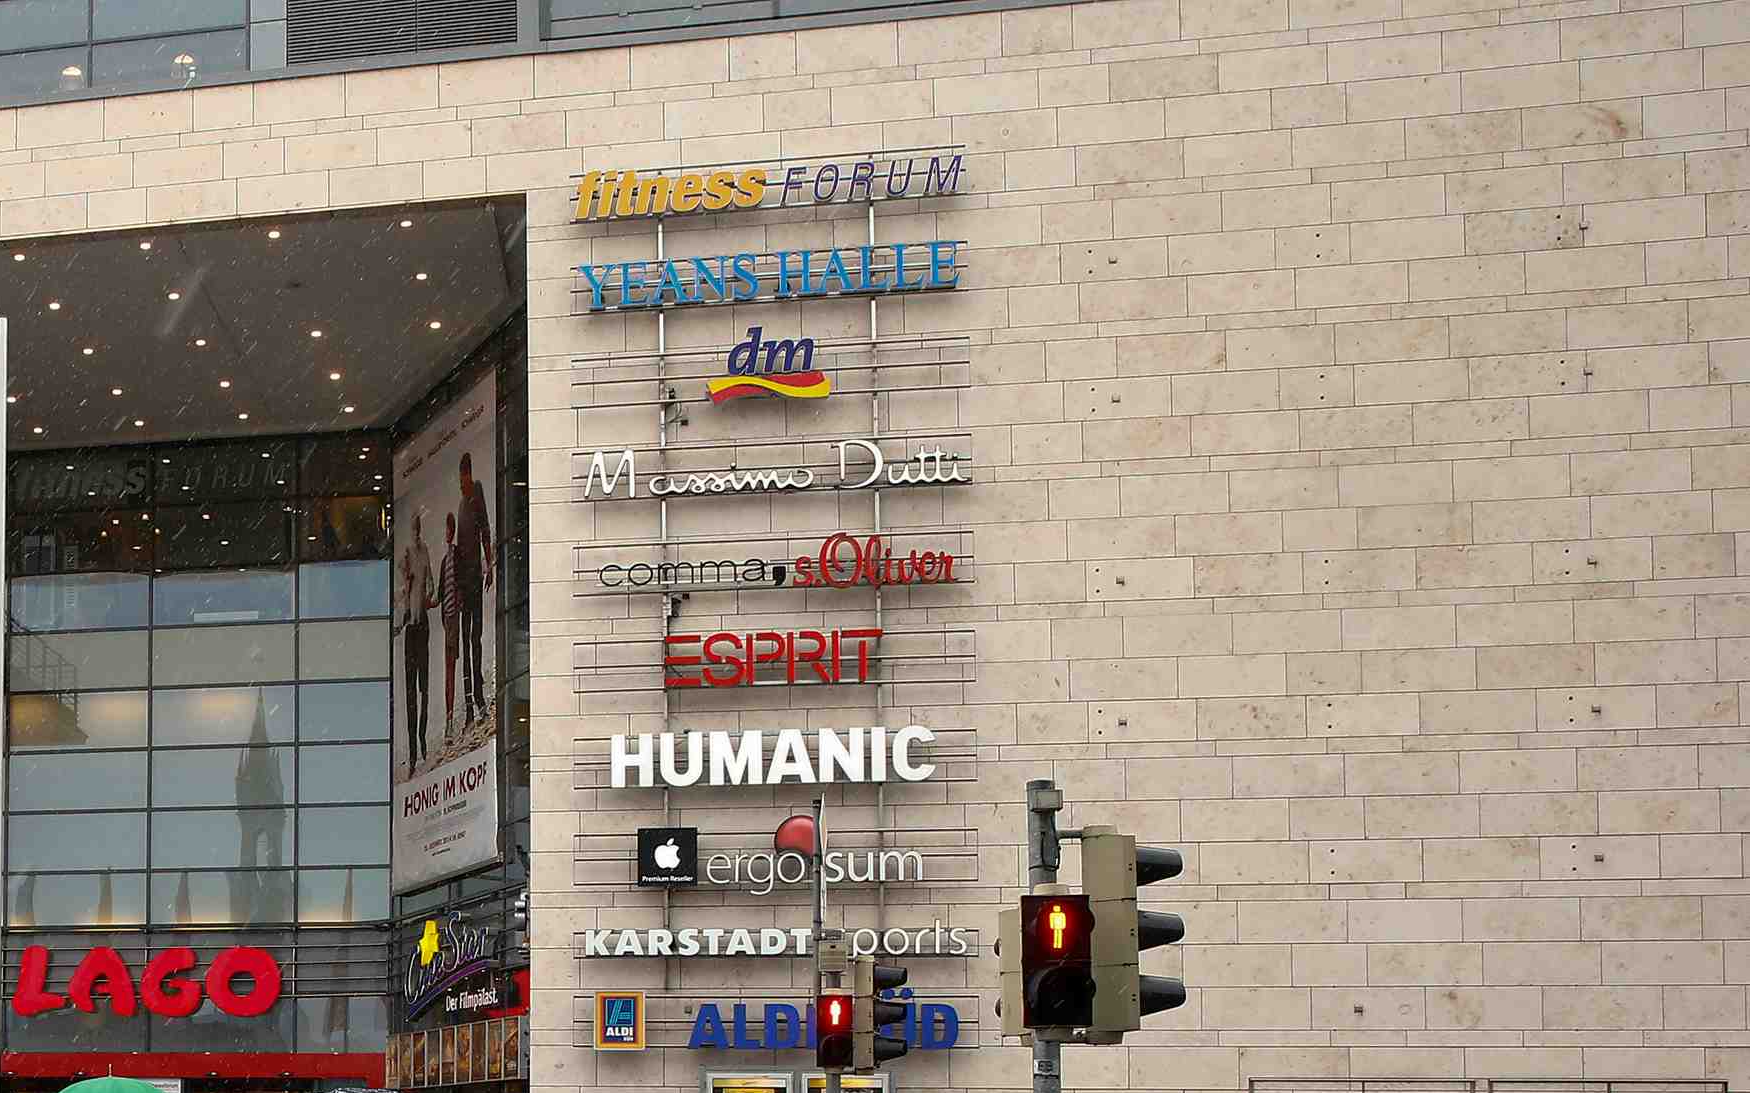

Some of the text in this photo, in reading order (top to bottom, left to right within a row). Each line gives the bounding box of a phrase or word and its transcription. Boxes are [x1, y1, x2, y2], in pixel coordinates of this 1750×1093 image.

[574, 154, 964, 221] fitness FORUM
[578, 241, 962, 311] YEANS HALLE
[728, 327, 815, 375] dm
[584, 439, 970, 499] Massimo Dutti
[600, 532, 956, 588] comma, s.Oliver
[664, 628, 883, 688] ESPRIT
[610, 725, 937, 788] HUMANIC
[404, 783, 439, 817] HONIG
[443, 776, 456, 800] IM
[459, 761, 487, 795] KOPF
[706, 850, 923, 895] ergo sum
[585, 918, 968, 959] KARSTADT ports
[12, 945, 281, 1018] LAGO
[445, 995, 458, 1012] Der
[605, 1027, 634, 1037] ALDI
[688, 1003, 818, 1050] ALDI
